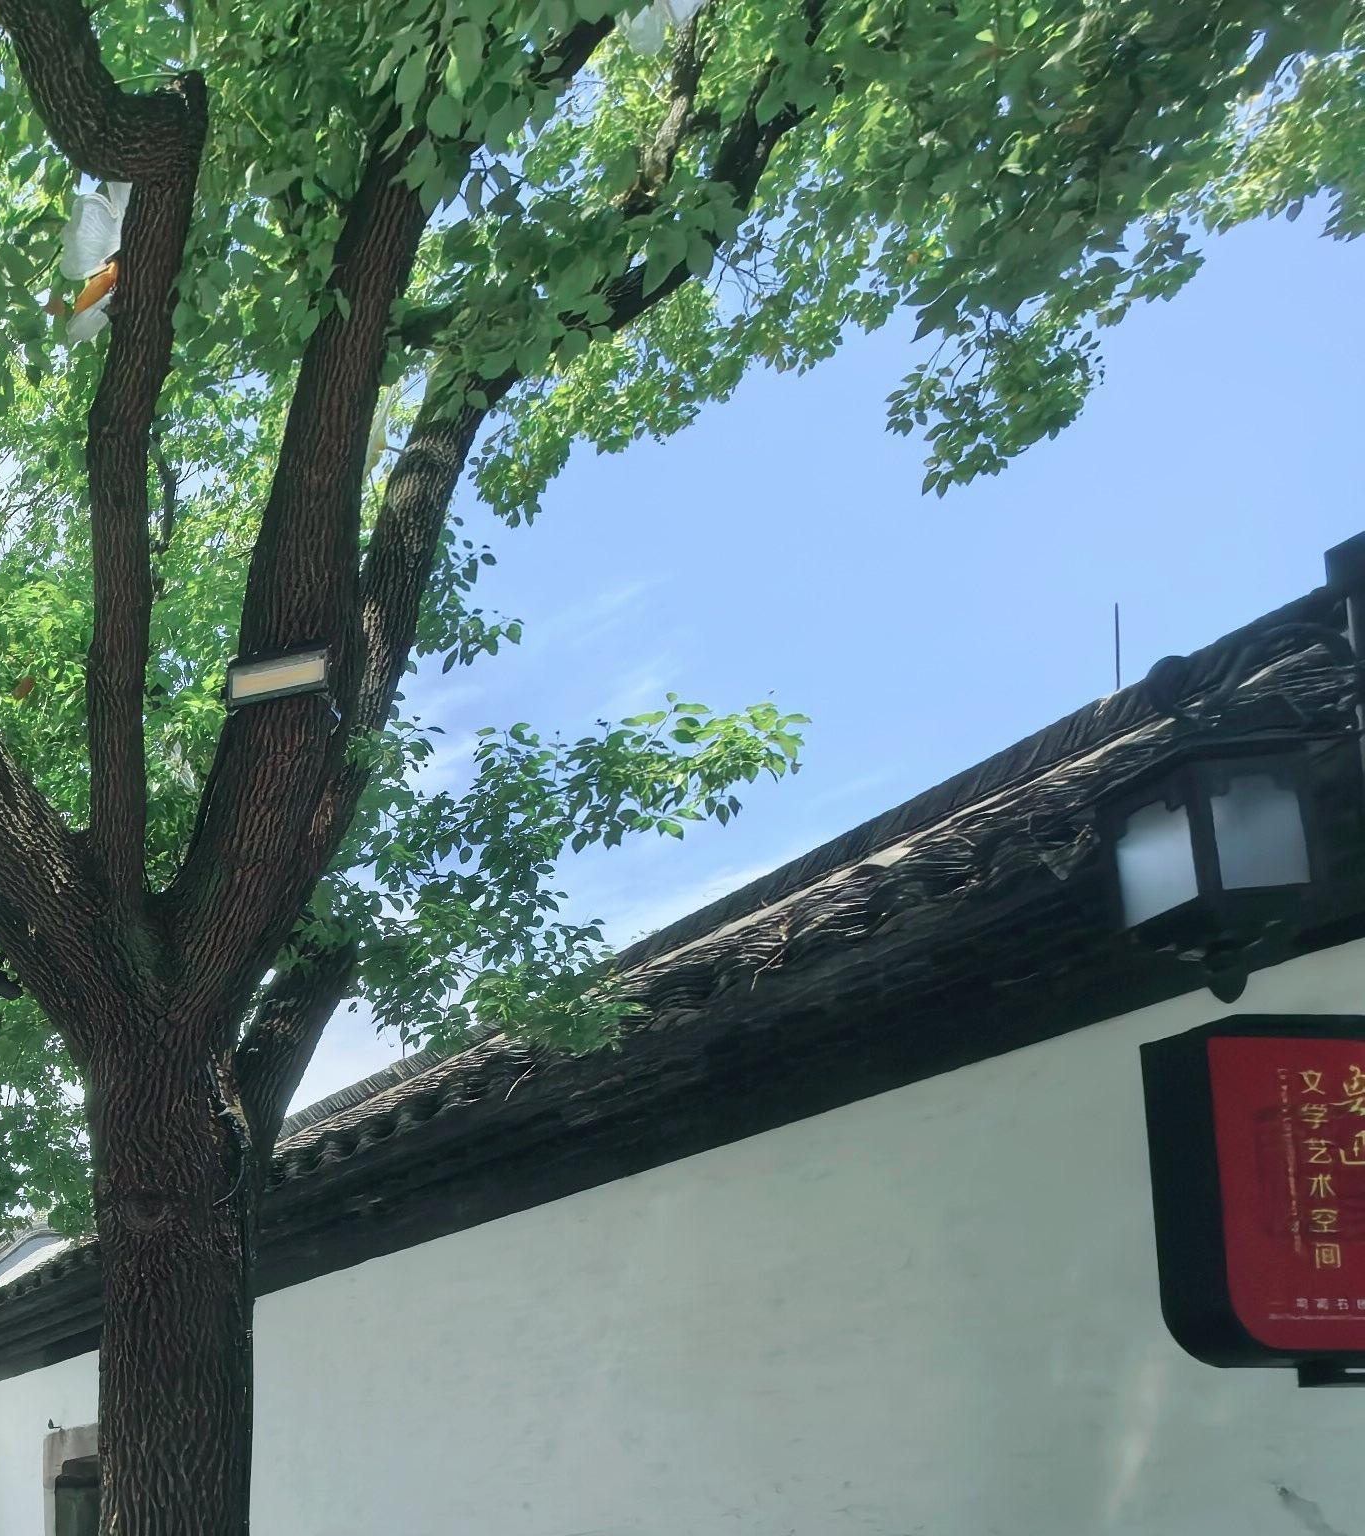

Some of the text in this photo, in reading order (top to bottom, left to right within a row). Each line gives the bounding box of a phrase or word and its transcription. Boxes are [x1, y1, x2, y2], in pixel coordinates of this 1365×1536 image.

[1299, 1070, 1341, 1269] 文学艺术空间
